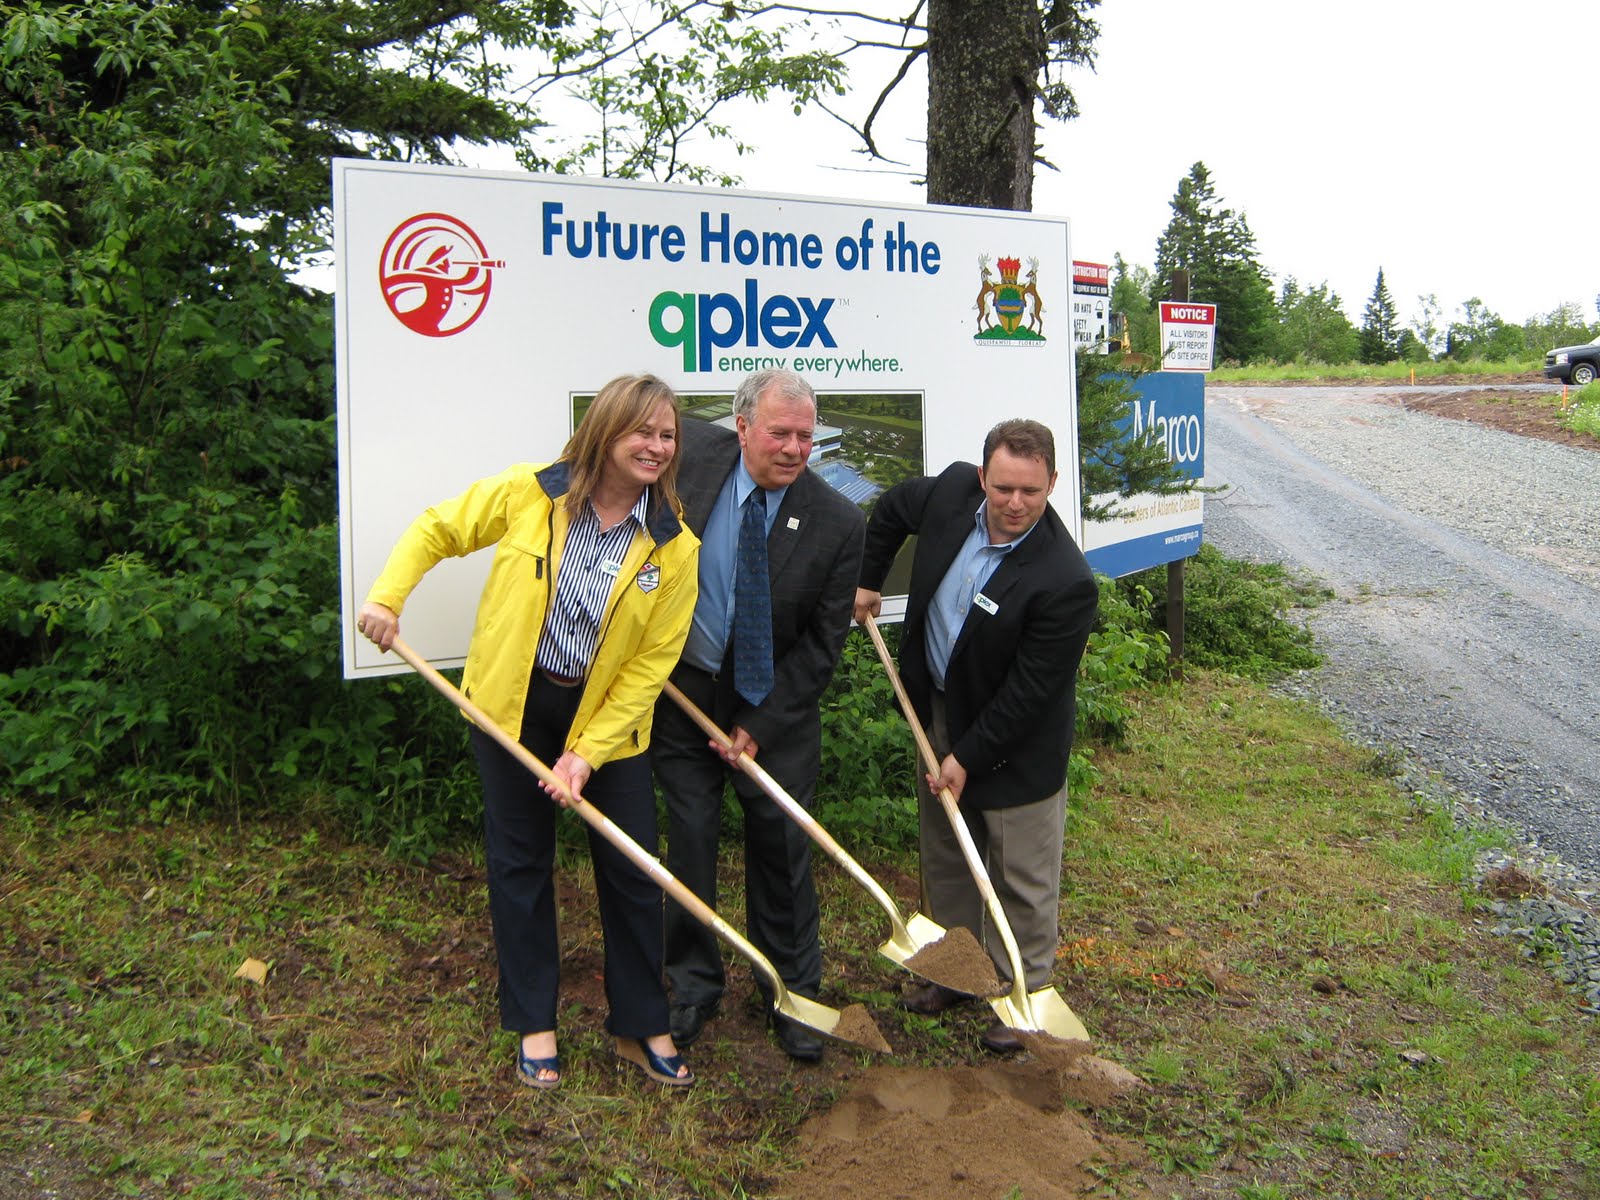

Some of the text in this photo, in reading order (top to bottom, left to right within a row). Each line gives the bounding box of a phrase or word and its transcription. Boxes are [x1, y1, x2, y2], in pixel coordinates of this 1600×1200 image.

[542, 201, 941, 275] Future Home of the
[1073, 266, 1098, 278] STRUCTION
[1170, 307, 1208, 320] NOTICE
[648, 278, 839, 373] qplex
[1170, 329, 1208, 339] ALL VISITORS
[1168, 340, 1208, 350] MUST REPORT
[1167, 351, 1209, 361] TO SITE OFFICE
[793, 349, 904, 379] everywhere.
[1132, 399, 1201, 463] Marco
[1150, 500, 1157, 519] of
[1157, 496, 1179, 518] Atlantic
[1179, 493, 1201, 513] Canada
[604, 561, 620, 573] qple
